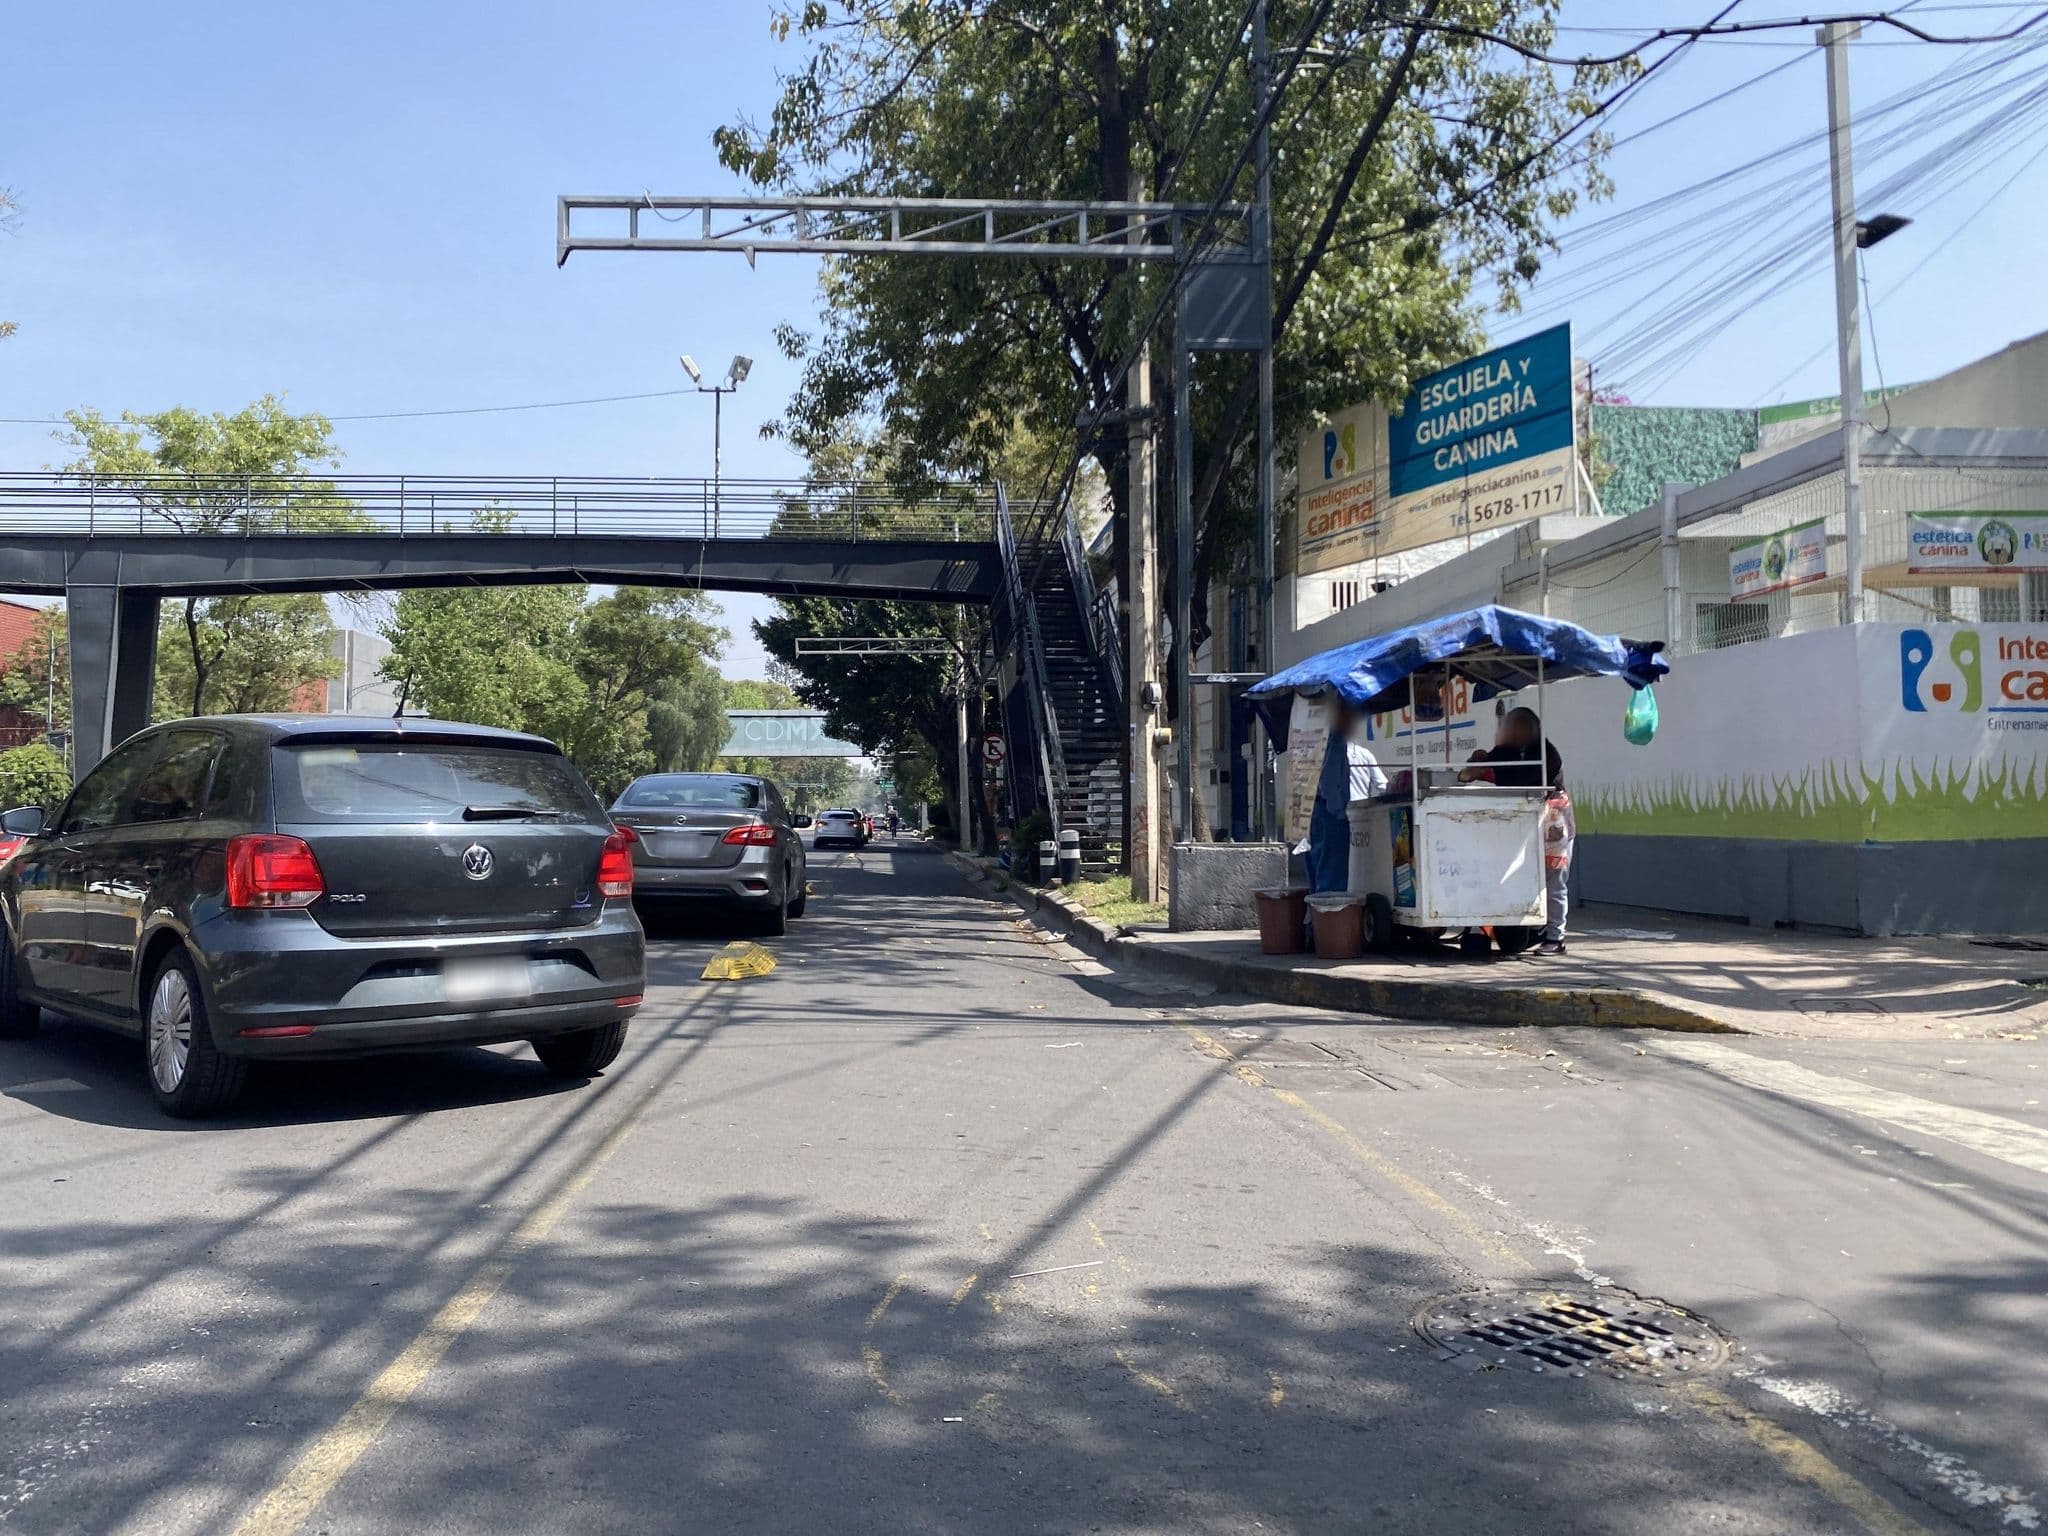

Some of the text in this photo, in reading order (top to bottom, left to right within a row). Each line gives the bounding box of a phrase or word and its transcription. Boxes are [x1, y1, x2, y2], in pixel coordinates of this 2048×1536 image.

[1420, 357, 1531, 412] ESCUELA Y
[1416, 381, 1537, 445] GUARDERÍA
[1434, 427, 1518, 471] CANINA
[1308, 480, 1373, 512] Inteligencia
[1474, 484, 1563, 523] 5678-1717
[1307, 500, 1373, 537] canina
[330, 893, 367, 903] POLO
